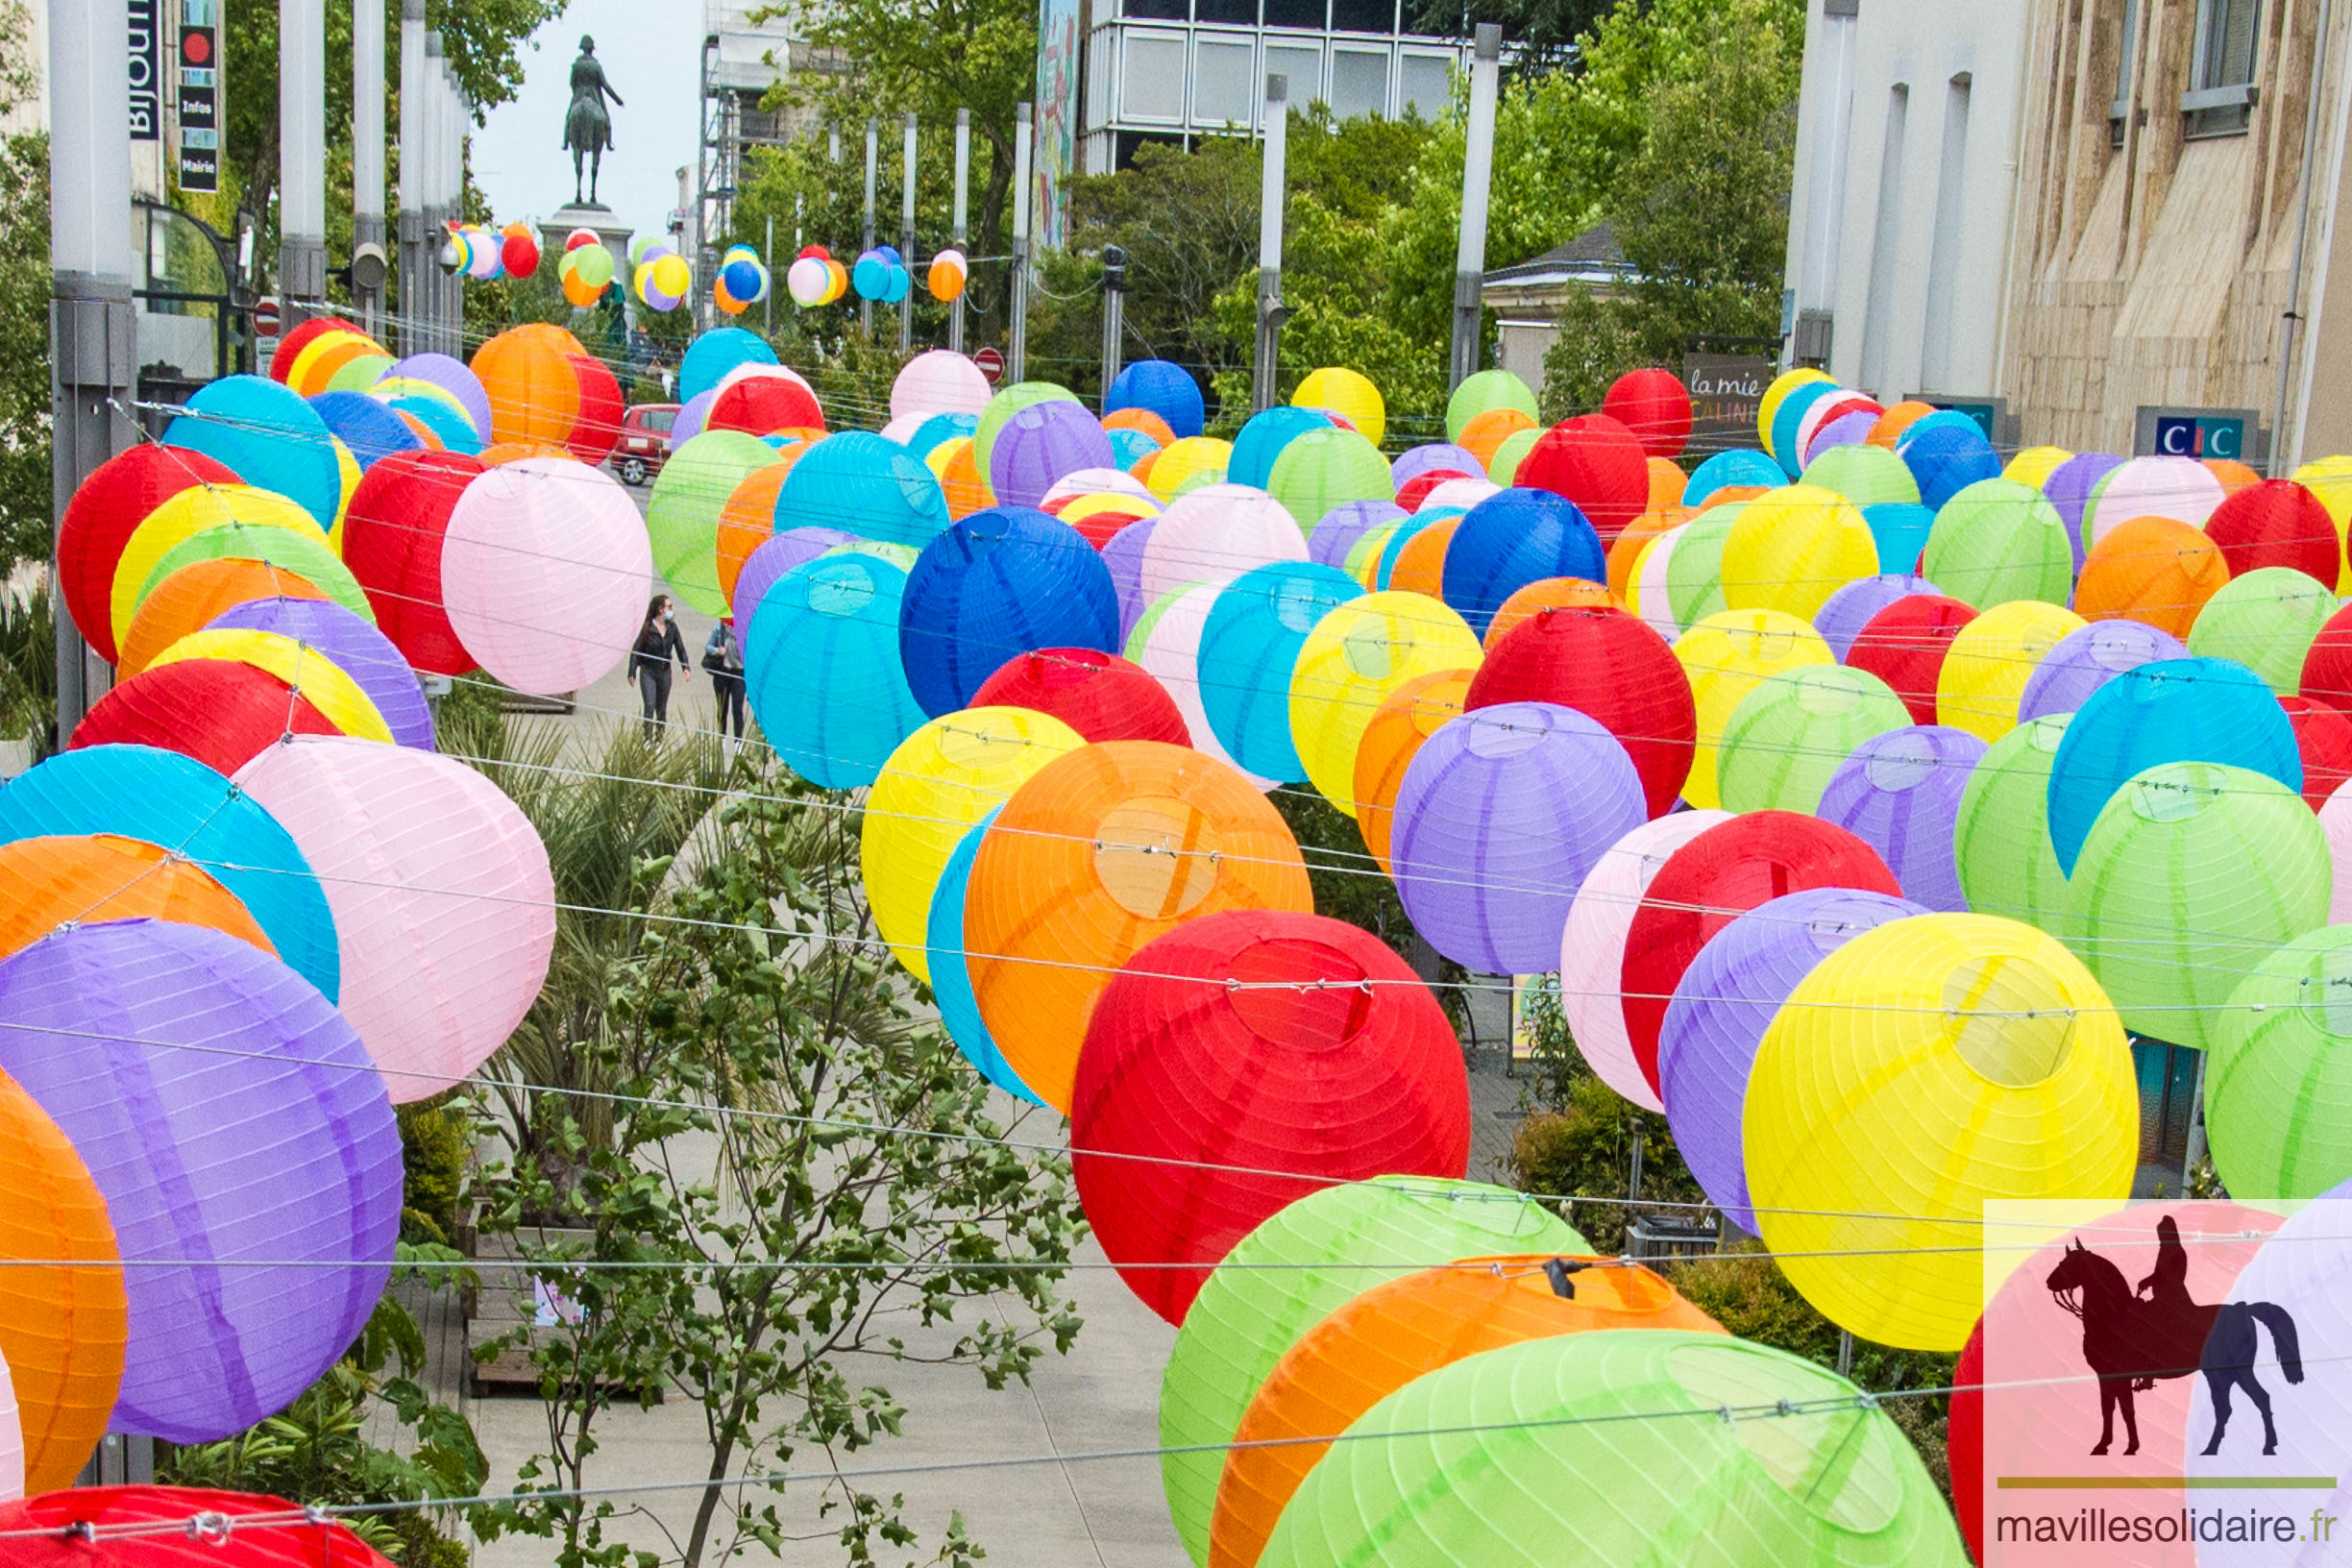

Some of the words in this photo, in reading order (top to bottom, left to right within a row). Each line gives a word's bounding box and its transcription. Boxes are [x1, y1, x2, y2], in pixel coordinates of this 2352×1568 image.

[183, 100, 211, 113] Infos
[183, 159, 215, 173] Mairie
[1691, 368, 1713, 394] la
[1716, 373, 1761, 397] mie
[2164, 426, 2234, 455] CIC
